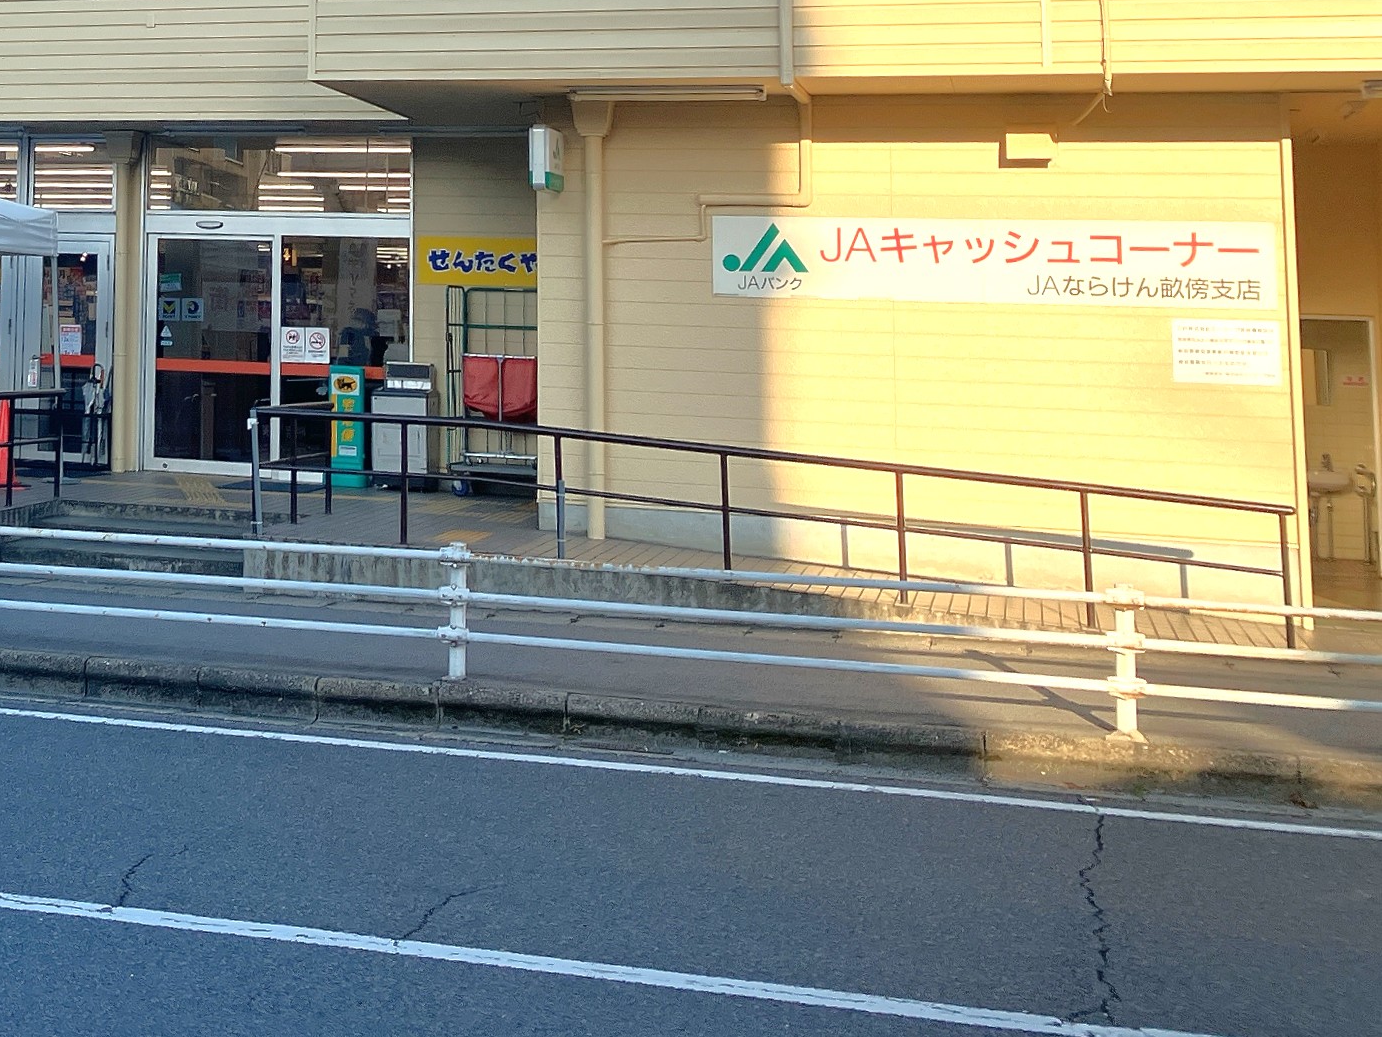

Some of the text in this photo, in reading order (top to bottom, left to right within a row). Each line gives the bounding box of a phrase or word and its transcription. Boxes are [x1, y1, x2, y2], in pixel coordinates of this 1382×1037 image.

[819, 226, 1260, 268] JAキャッシュコーナー
[426, 248, 538, 275] せんたくや
[737, 274, 803, 292] JAバンク
[1026, 274, 1262, 302] JAならけん畝傍支店
